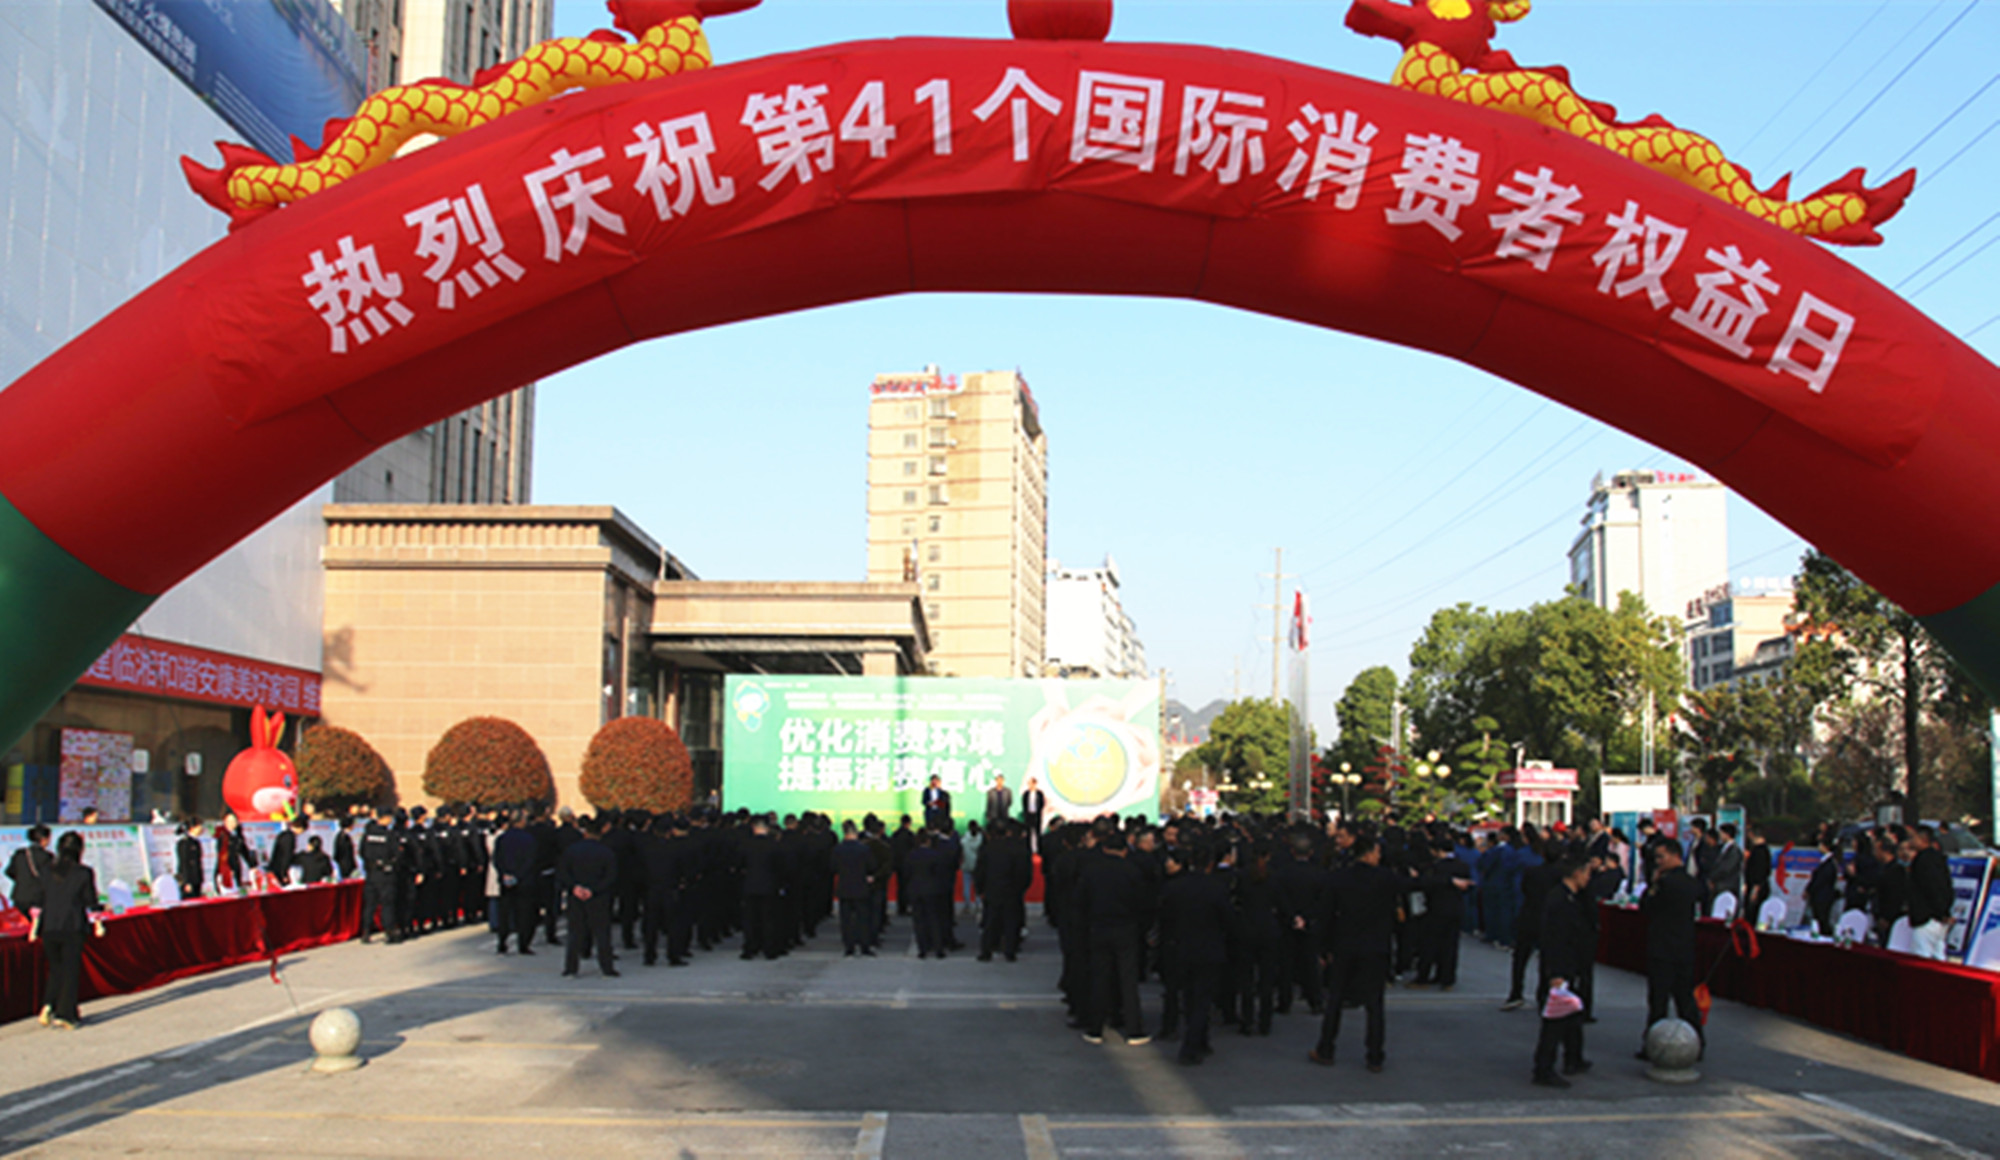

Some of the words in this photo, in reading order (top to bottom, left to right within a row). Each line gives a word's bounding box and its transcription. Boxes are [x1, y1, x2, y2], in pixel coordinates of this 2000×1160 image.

[302, 67, 1855, 393] 热烈庆祝第41个国际消费者权益日
[779, 717, 1005, 756] 优化消费环境
[778, 755, 1005, 793] 提振消费信心
